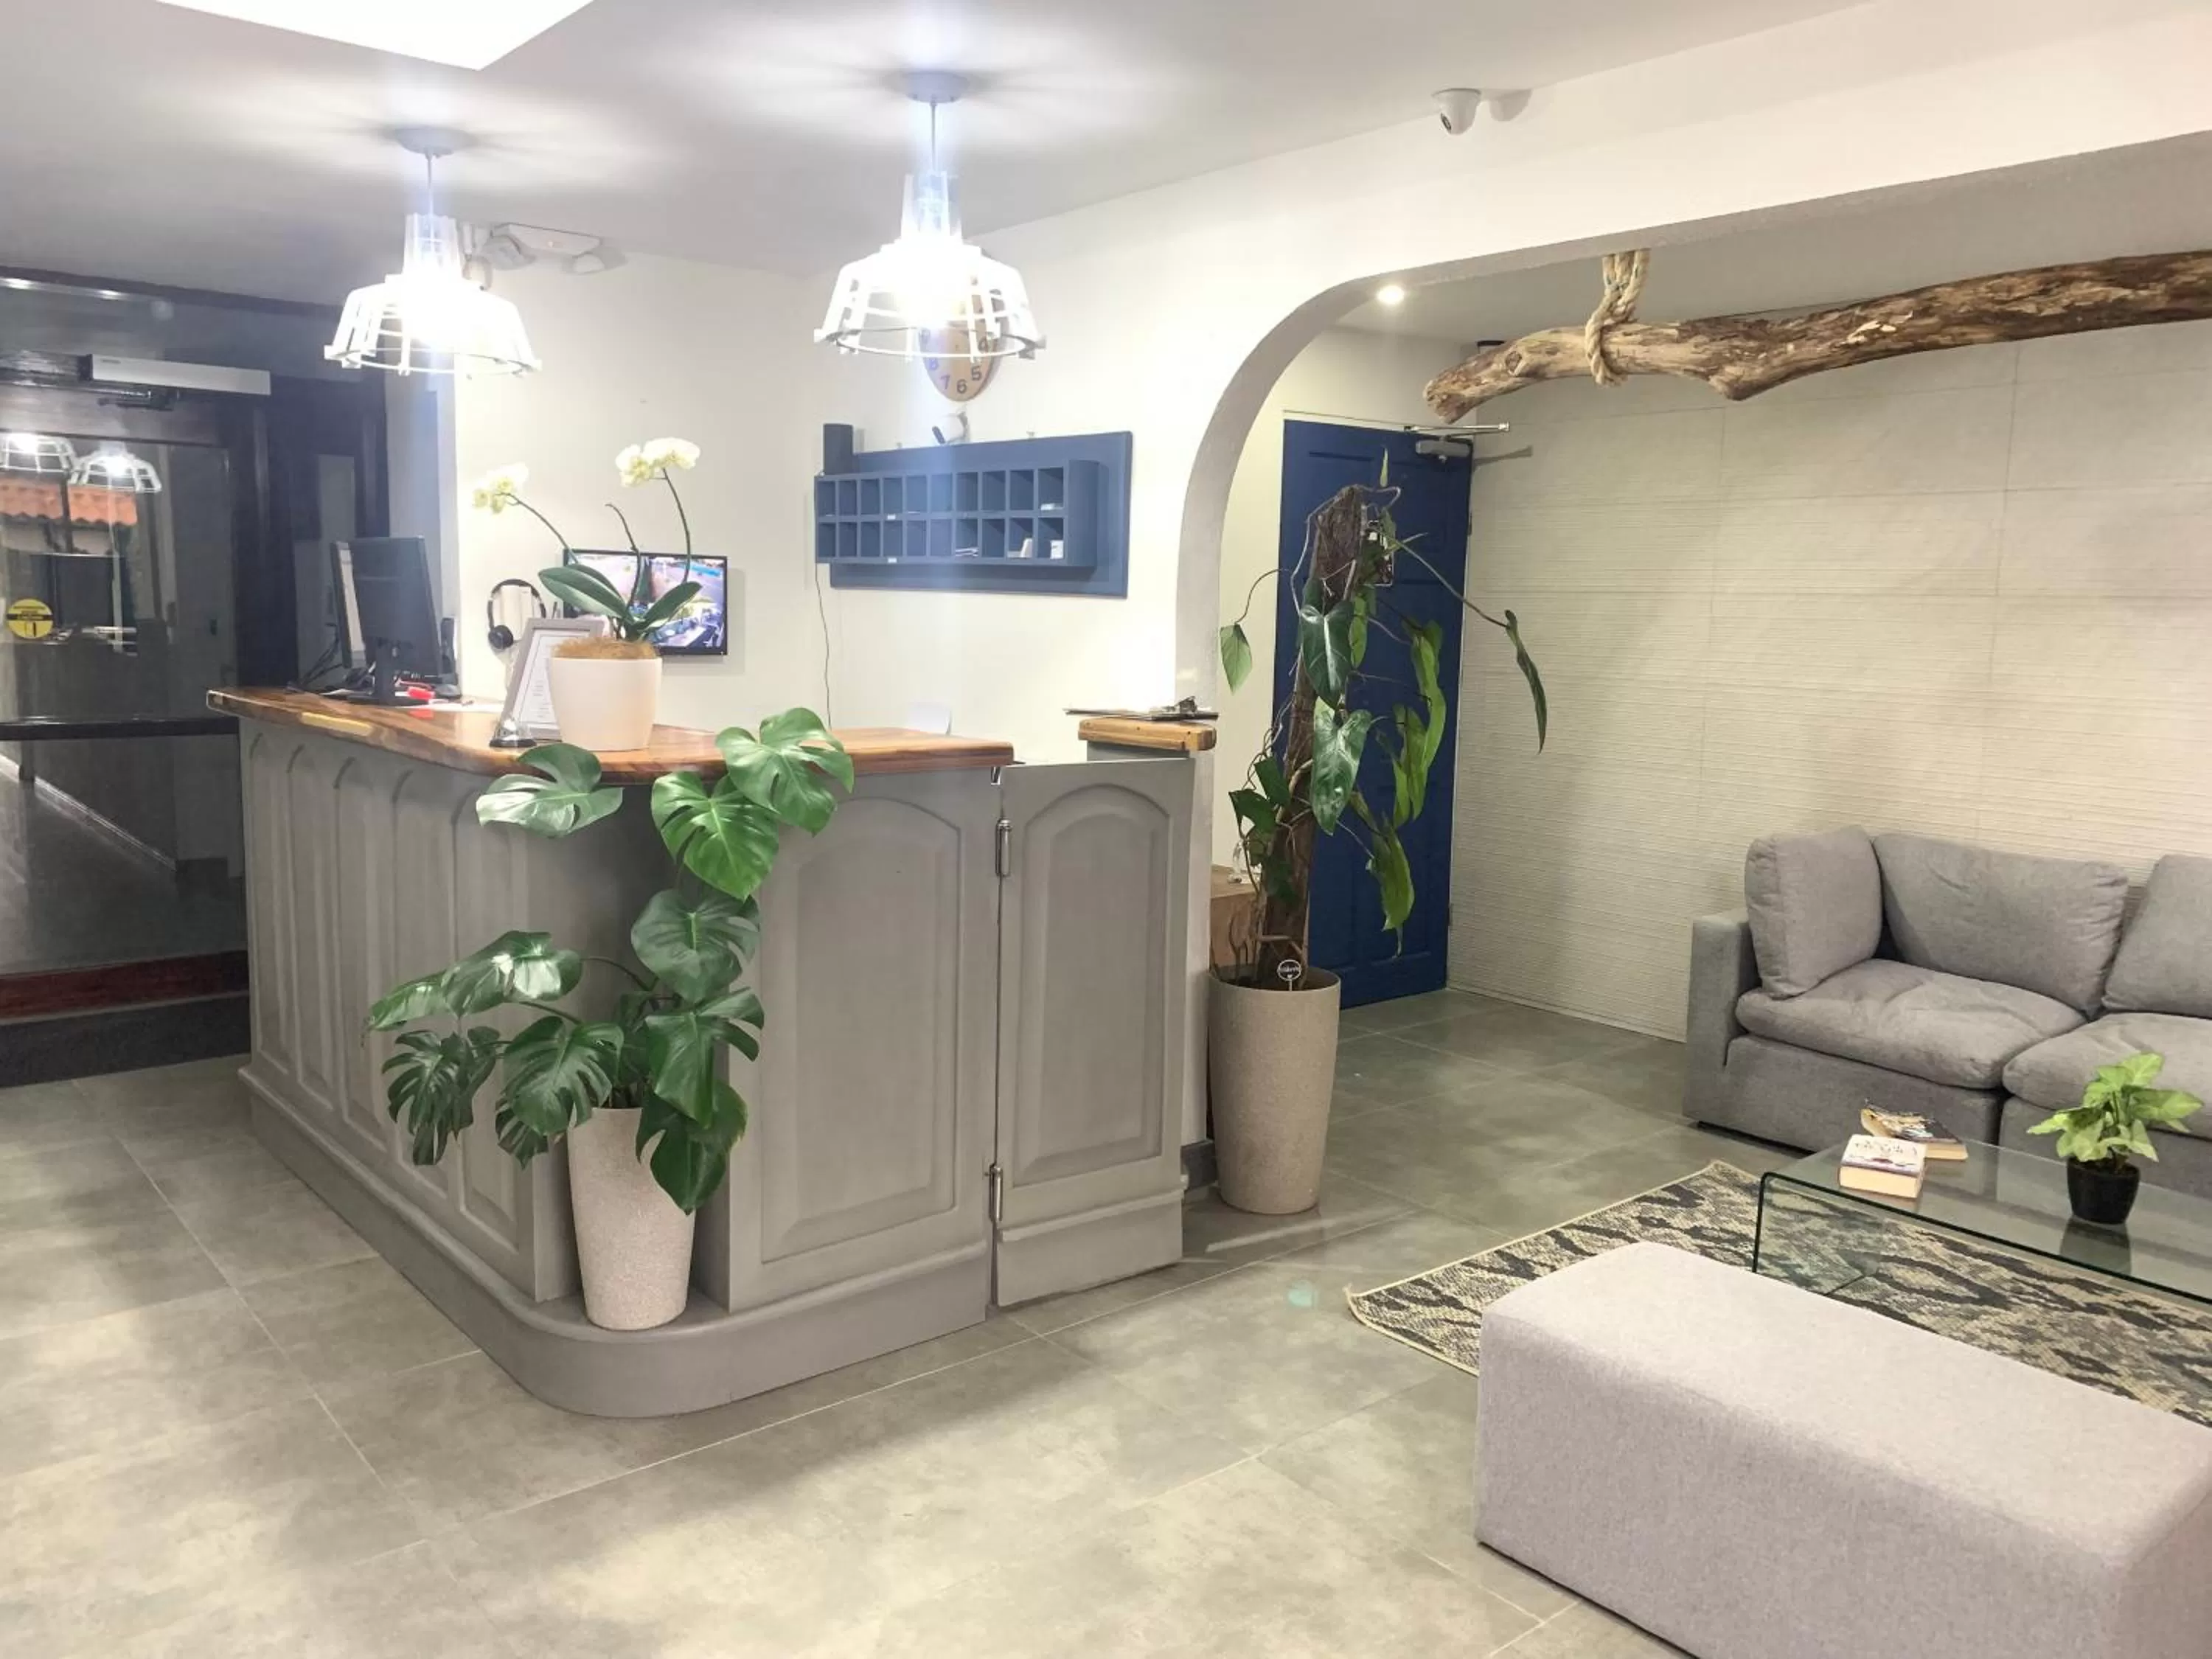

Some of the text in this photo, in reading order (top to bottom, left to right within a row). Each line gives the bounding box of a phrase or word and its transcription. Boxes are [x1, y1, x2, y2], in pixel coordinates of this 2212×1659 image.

[971, 366, 981, 380] 5
[940, 375, 950, 389] 7
[957, 379, 967, 394] 6
